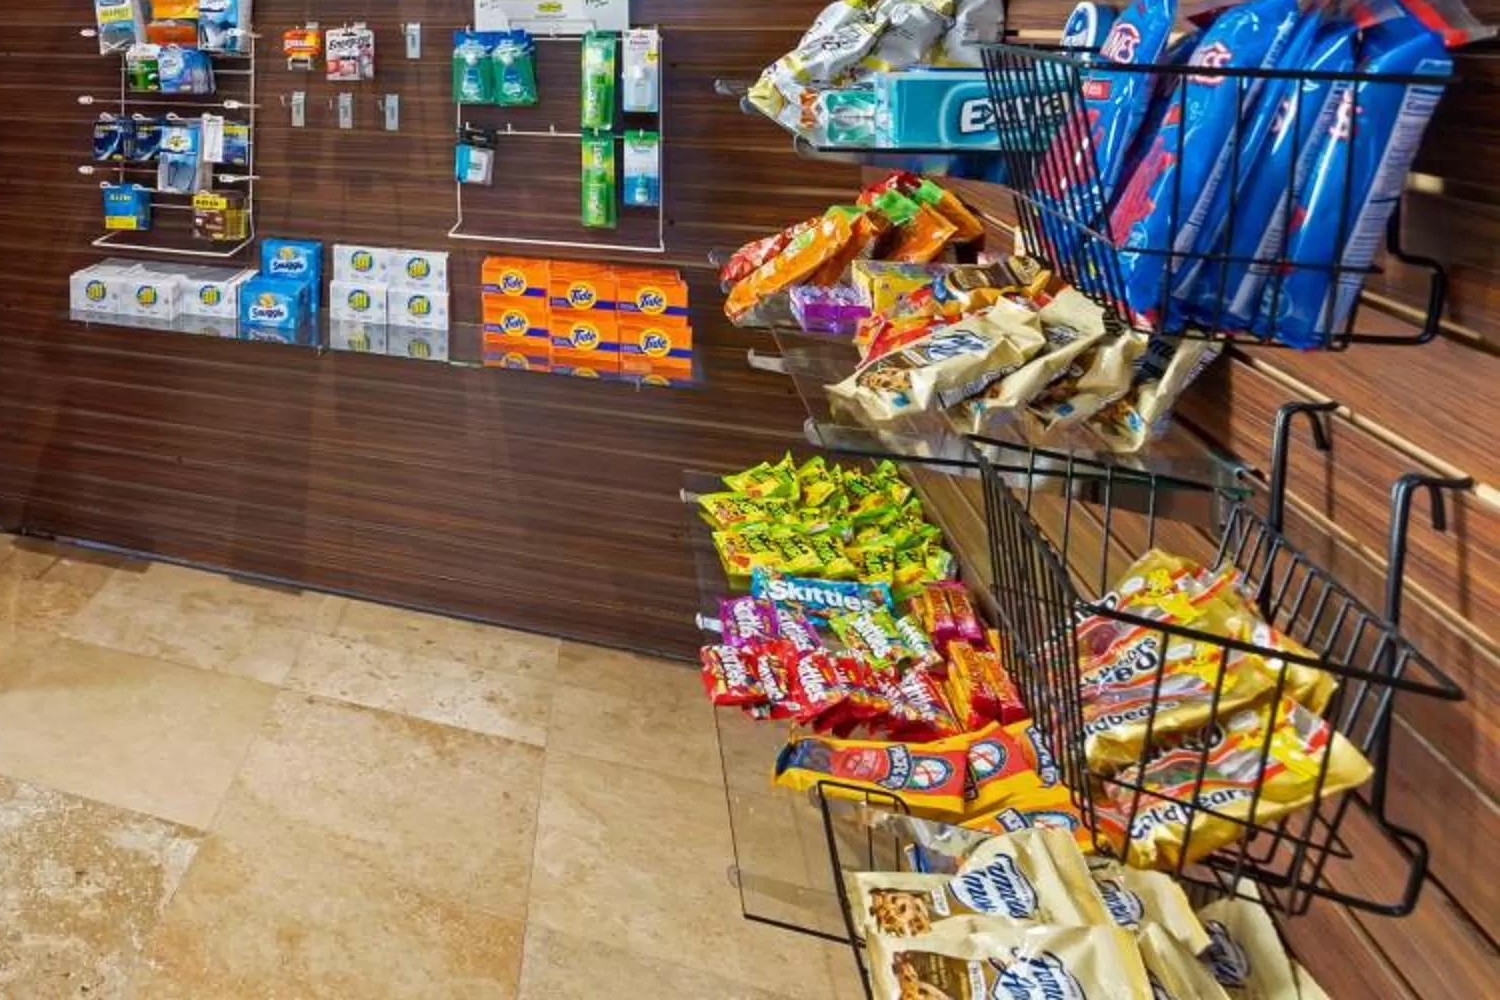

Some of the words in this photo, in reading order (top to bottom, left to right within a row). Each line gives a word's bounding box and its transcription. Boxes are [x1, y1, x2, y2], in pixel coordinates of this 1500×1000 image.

[502, 276, 525, 291] Tide
[571, 289, 594, 303] Tide
[639, 293, 663, 308] Tide
[504, 315, 527, 330] Tide
[574, 330, 597, 345] Tide
[643, 335, 667, 351] Tide
